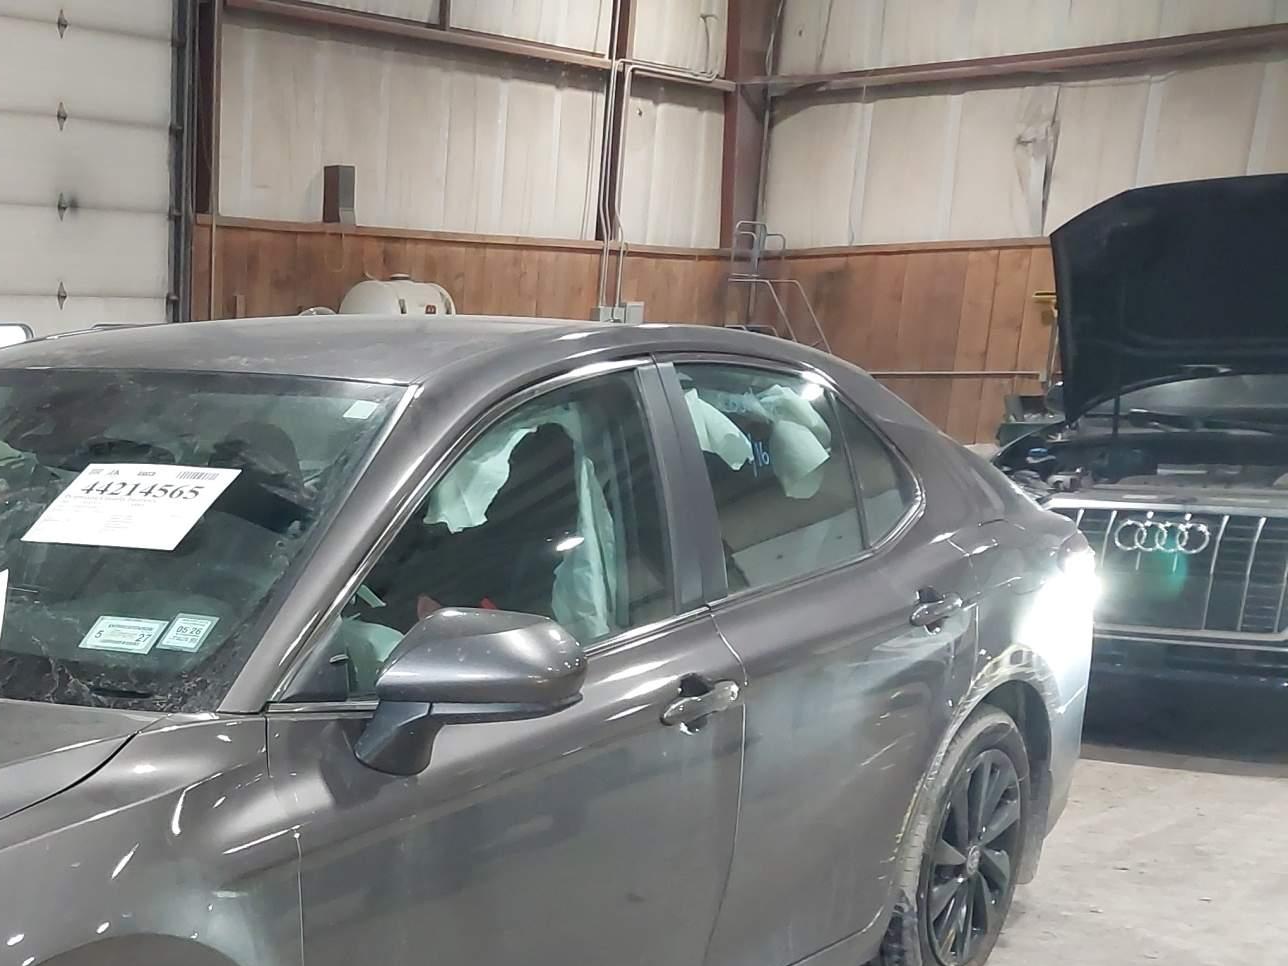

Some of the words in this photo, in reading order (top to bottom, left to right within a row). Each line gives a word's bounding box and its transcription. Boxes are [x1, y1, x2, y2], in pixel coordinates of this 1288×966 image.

[80, 481, 206, 500] 44214565
[94, 630, 105, 639] 5
[135, 633, 152, 643] 27
[176, 625, 189, 634] 05
[190, 626, 202, 635] 26
